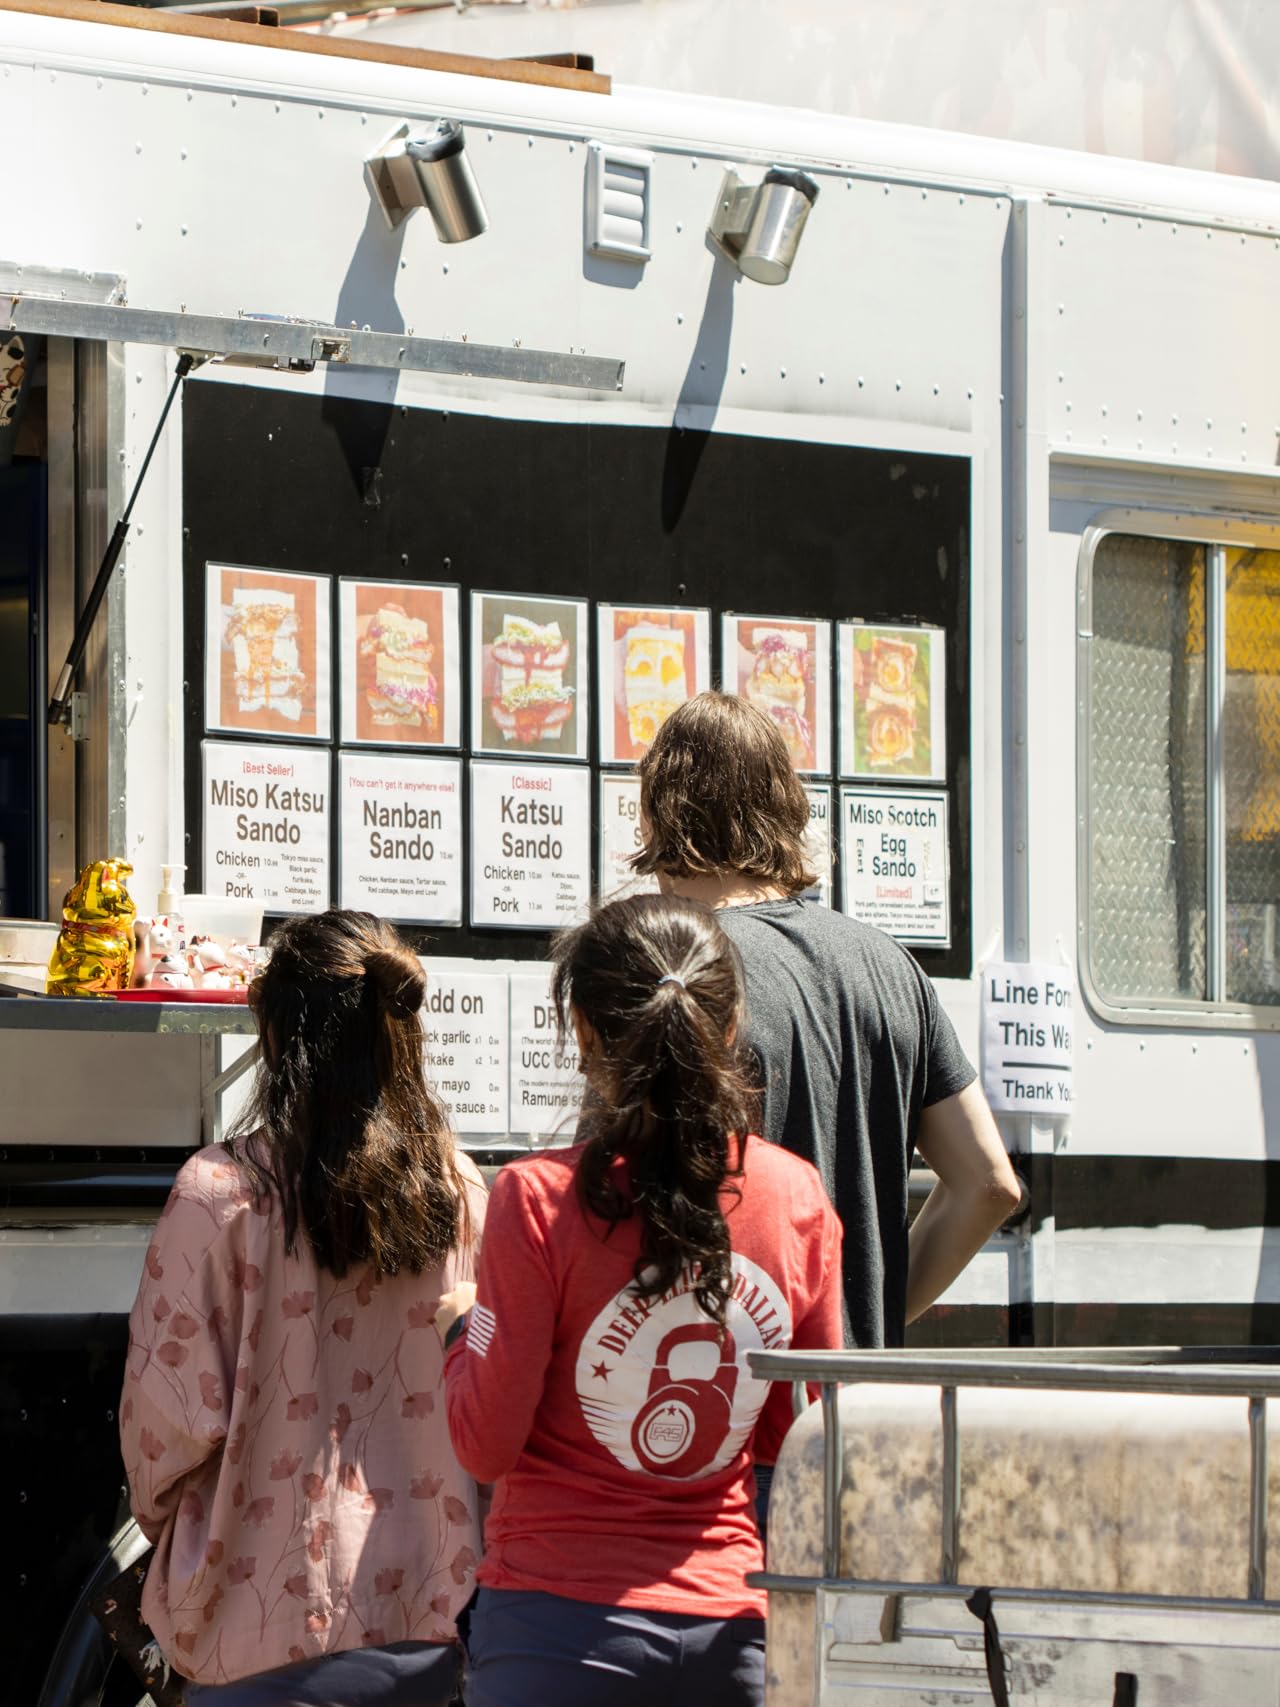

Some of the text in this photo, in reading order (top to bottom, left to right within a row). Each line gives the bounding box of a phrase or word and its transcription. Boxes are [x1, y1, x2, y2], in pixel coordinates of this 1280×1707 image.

[512, 776, 552, 791] [Classic]
[211, 779, 324, 813] Miso Katsu
[363, 800, 441, 829] Nanban
[501, 795, 563, 825] Katsu
[618, 796, 641, 821] Eg
[850, 803, 937, 827] Miso Scotch
[237, 814, 301, 844] Sando
[370, 832, 434, 860] Sando
[502, 832, 562, 859] Sando
[881, 833, 907, 857] Egg
[216, 850, 260, 867] Chicken
[872, 856, 916, 877] Sando
[484, 865, 525, 880] Chicken
[226, 882, 254, 898] Pork
[493, 897, 519, 912] Pork
[991, 979, 1039, 1005] Line
[461, 994, 483, 1014] on
[442, 1030, 471, 1045] garlic
[998, 1021, 1046, 1047] This
[522, 1051, 578, 1070] UCC Cof
[442, 1080, 470, 1093] mayo
[1002, 1079, 1054, 1100] Thank
[455, 1103, 486, 1113] sauce
[522, 1090, 569, 1107] Ramune
